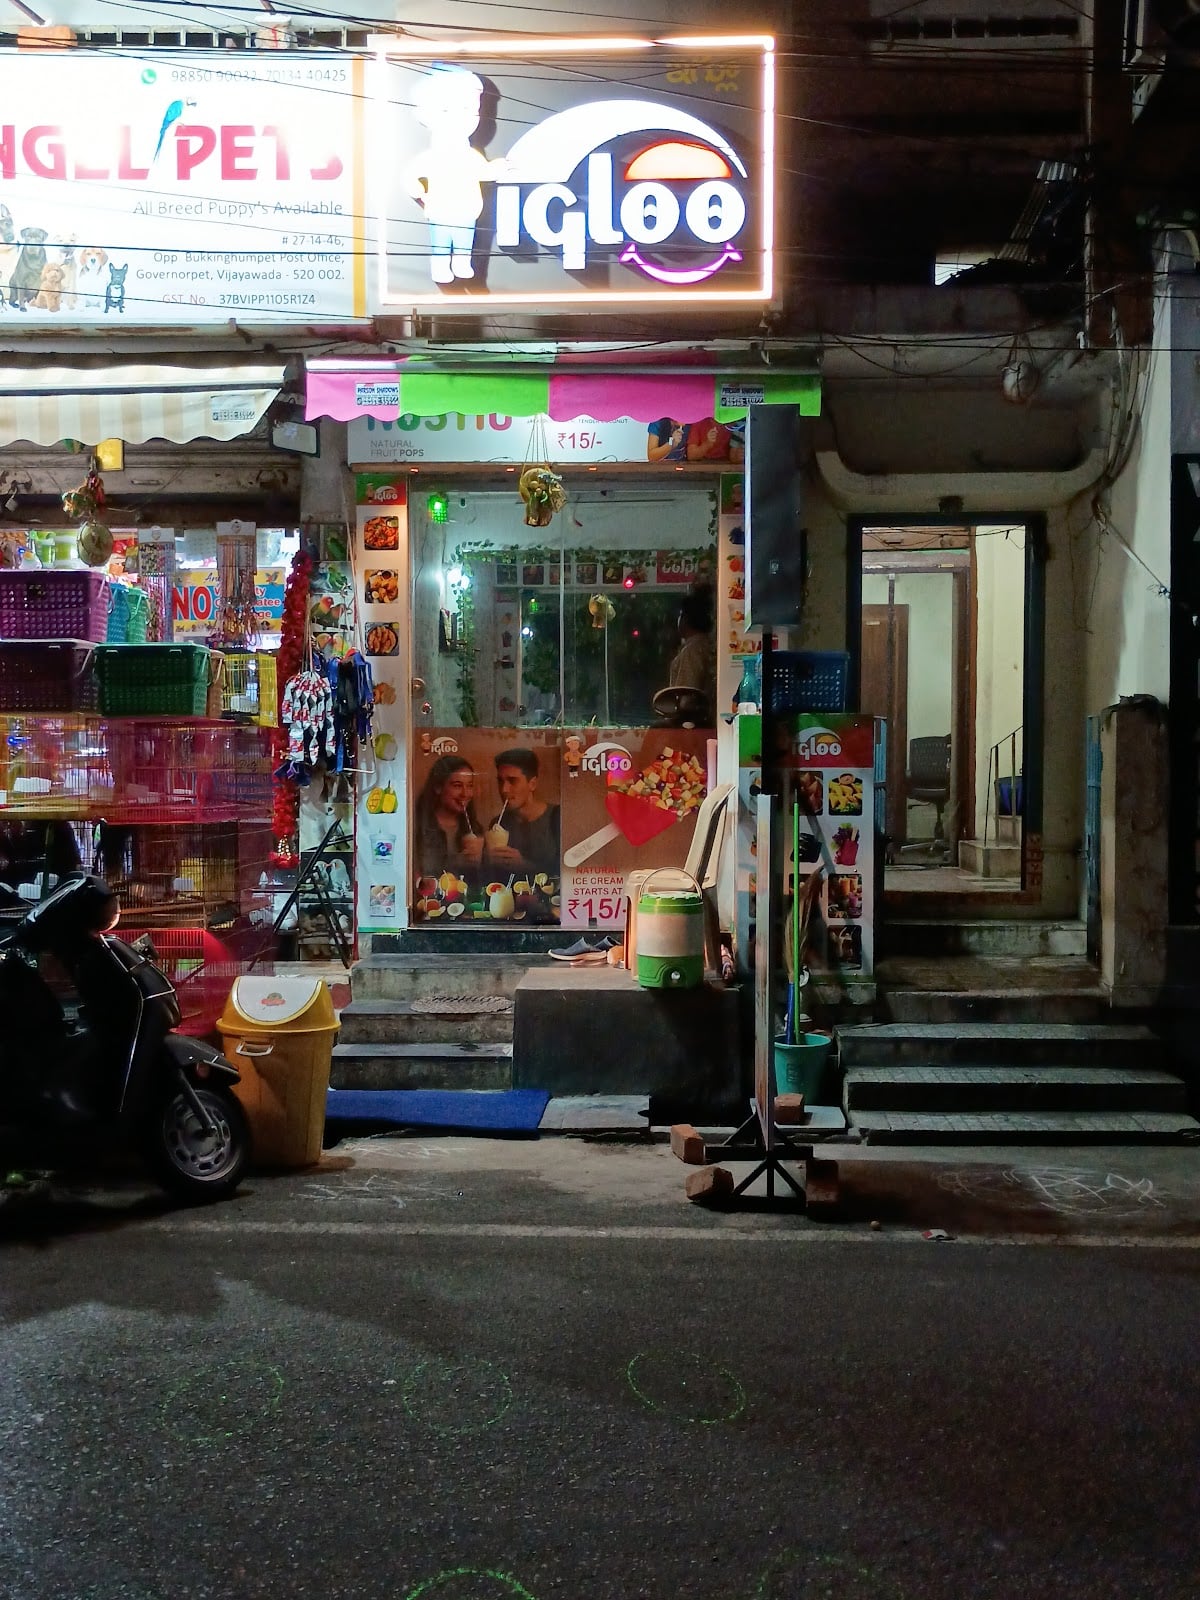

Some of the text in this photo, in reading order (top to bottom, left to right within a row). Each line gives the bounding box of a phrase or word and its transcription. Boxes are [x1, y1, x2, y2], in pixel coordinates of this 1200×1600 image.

[171, 69, 212, 82] 98850
[216, 70, 257, 82] 90032
[306, 70, 347, 82] 40425
[133, 201, 343, 218] All Breed Puppy's Available
[496, 153, 746, 270] igloo
[280, 252, 304, 263] Post
[136, 269, 214, 281] Governorpet,
[217, 269, 282, 282] Vijayawada
[293, 269, 315, 280] 520
[318, 269, 345, 280] 002.
[162, 294, 185, 304] GST
[370, 440, 415, 448] NATURAL
[558, 432, 602, 449] ₹15/-
[370, 449, 425, 457] FRUIT POPS
[172, 586, 212, 620] NO
[431, 743, 458, 754] igloo
[582, 753, 632, 775] igloo
[576, 866, 620, 874] NATURAL
[572, 877, 624, 885] ICE CREAM
[573, 888, 623, 896] STARTS AT
